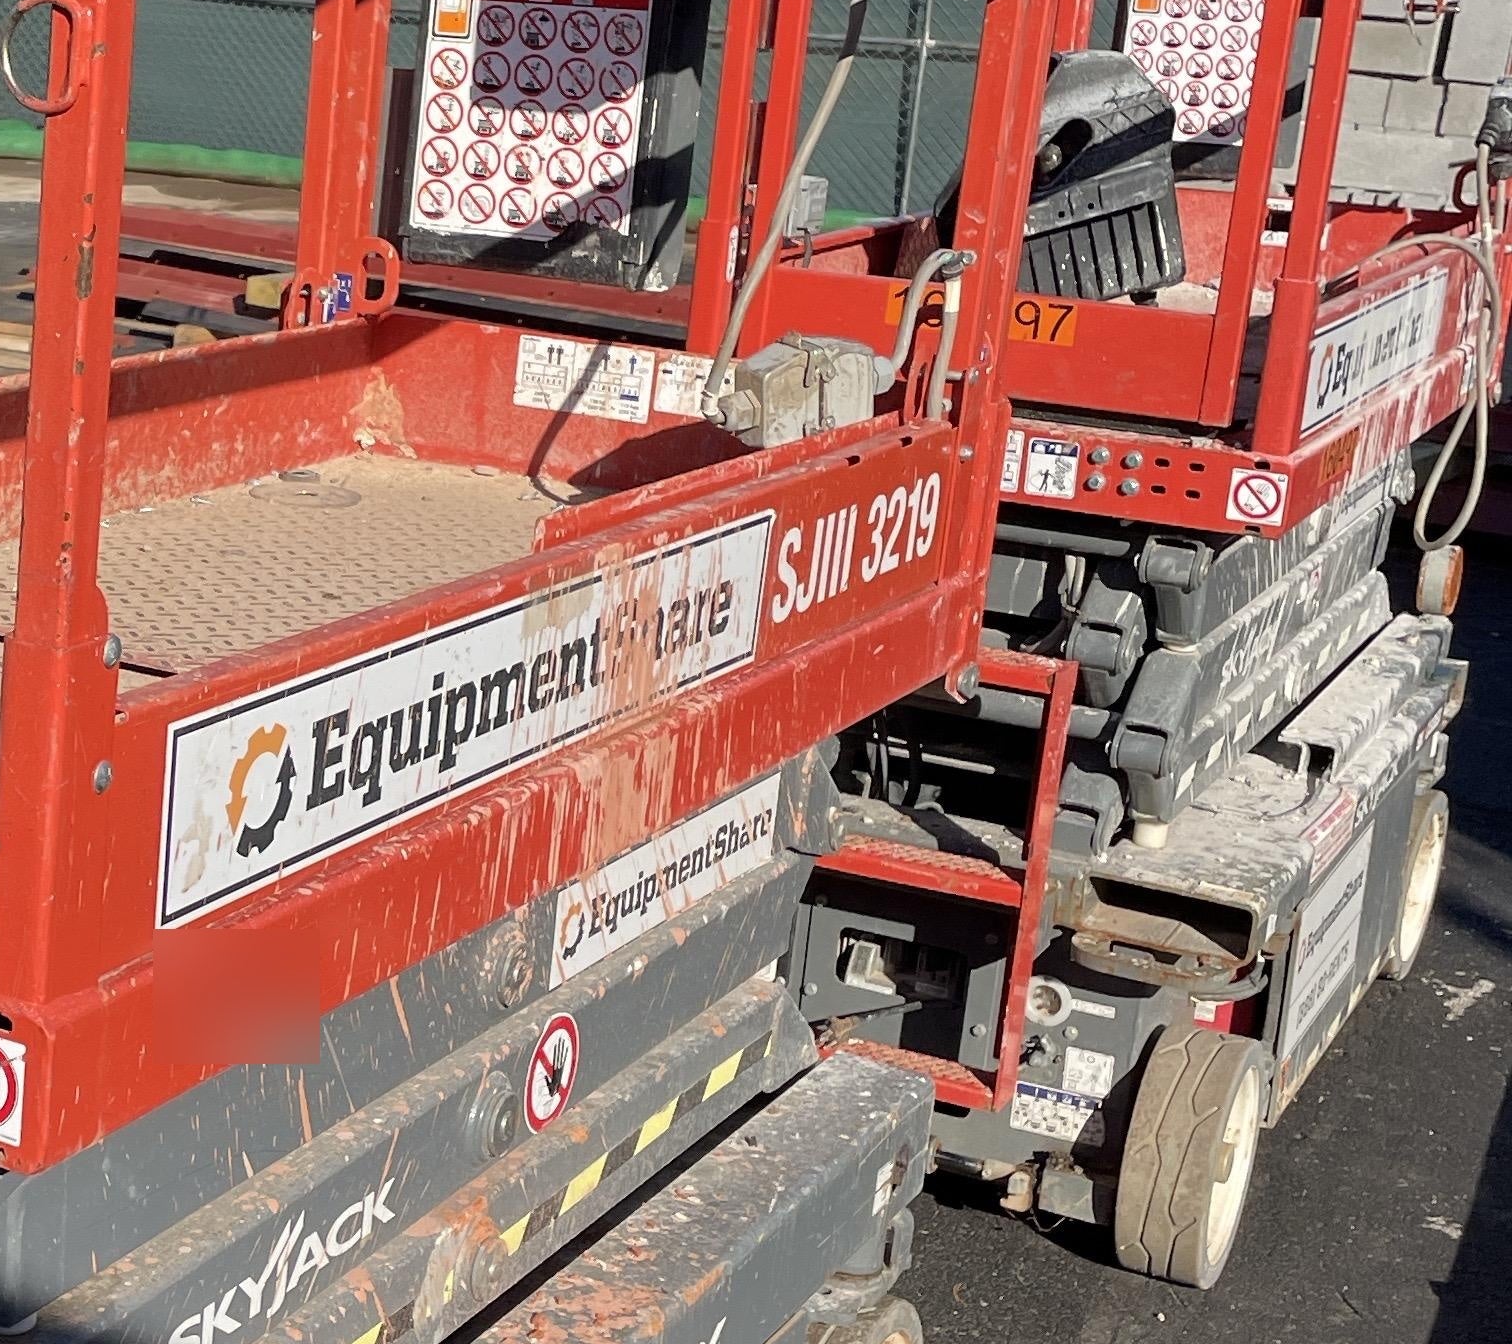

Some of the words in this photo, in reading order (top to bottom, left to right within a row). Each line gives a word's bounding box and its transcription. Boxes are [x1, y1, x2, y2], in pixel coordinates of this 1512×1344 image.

[771, 504, 858, 624] SJIII
[861, 472, 941, 583] 3219
[587, 807, 773, 939] EquipmentShare
